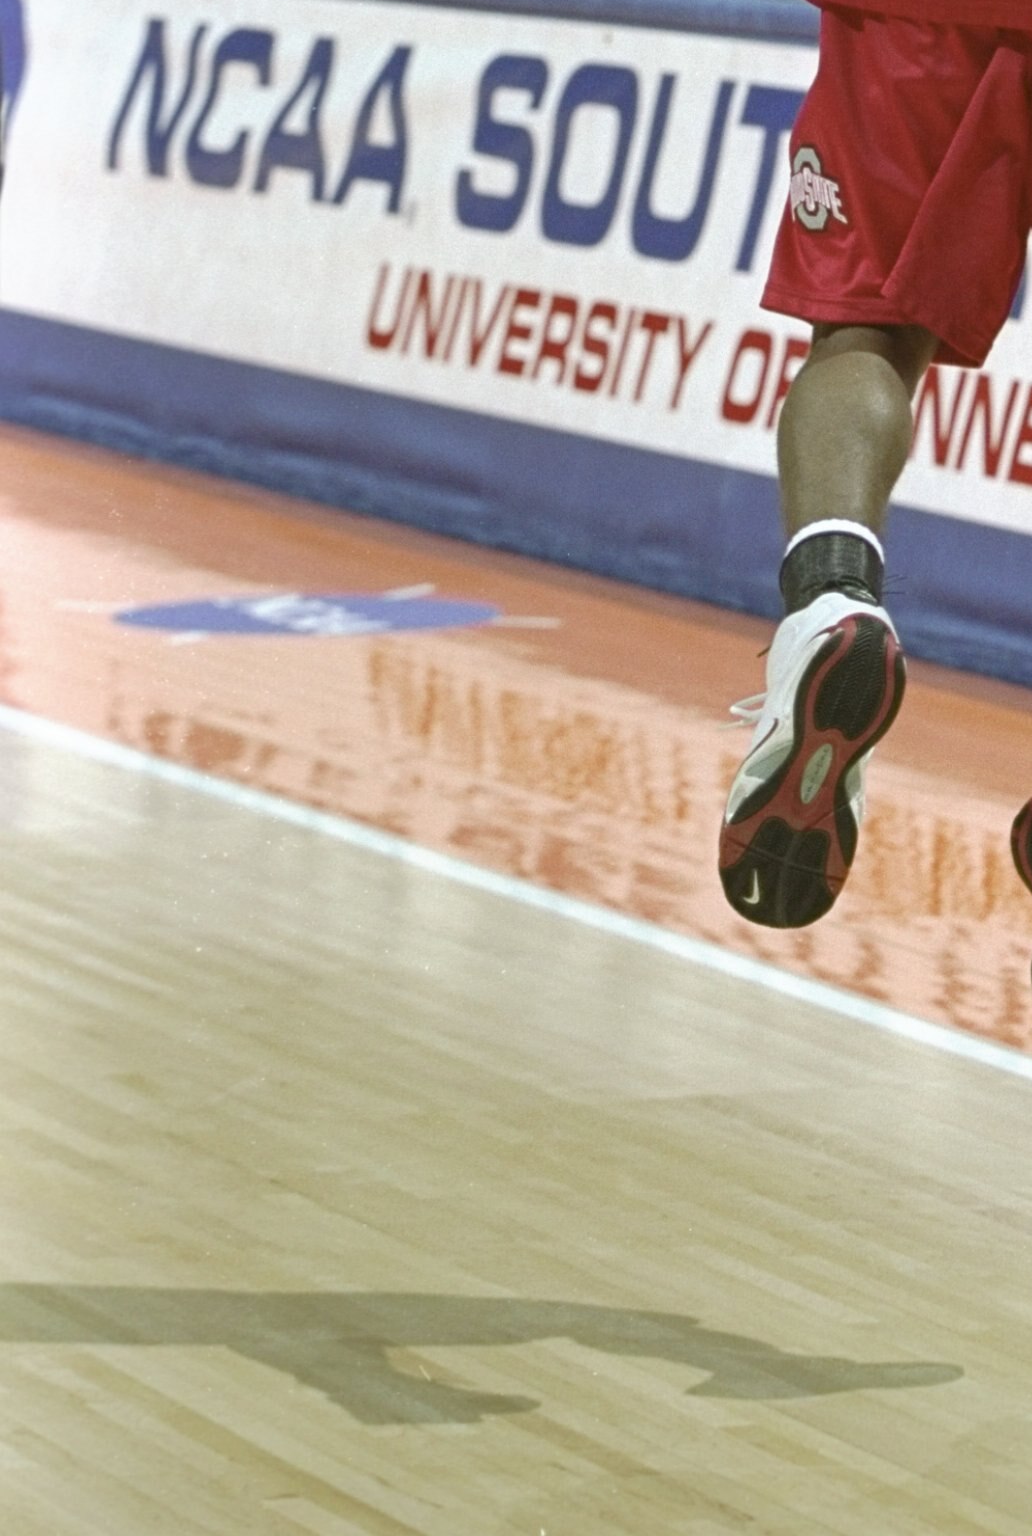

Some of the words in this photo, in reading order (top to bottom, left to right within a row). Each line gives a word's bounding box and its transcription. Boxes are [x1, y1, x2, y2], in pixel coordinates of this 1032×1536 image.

[107, 17, 413, 216] NCAA
[455, 52, 806, 272] SOUT
[366, 264, 715, 412] UNIVERSITY
[720, 328, 812, 431] OF
